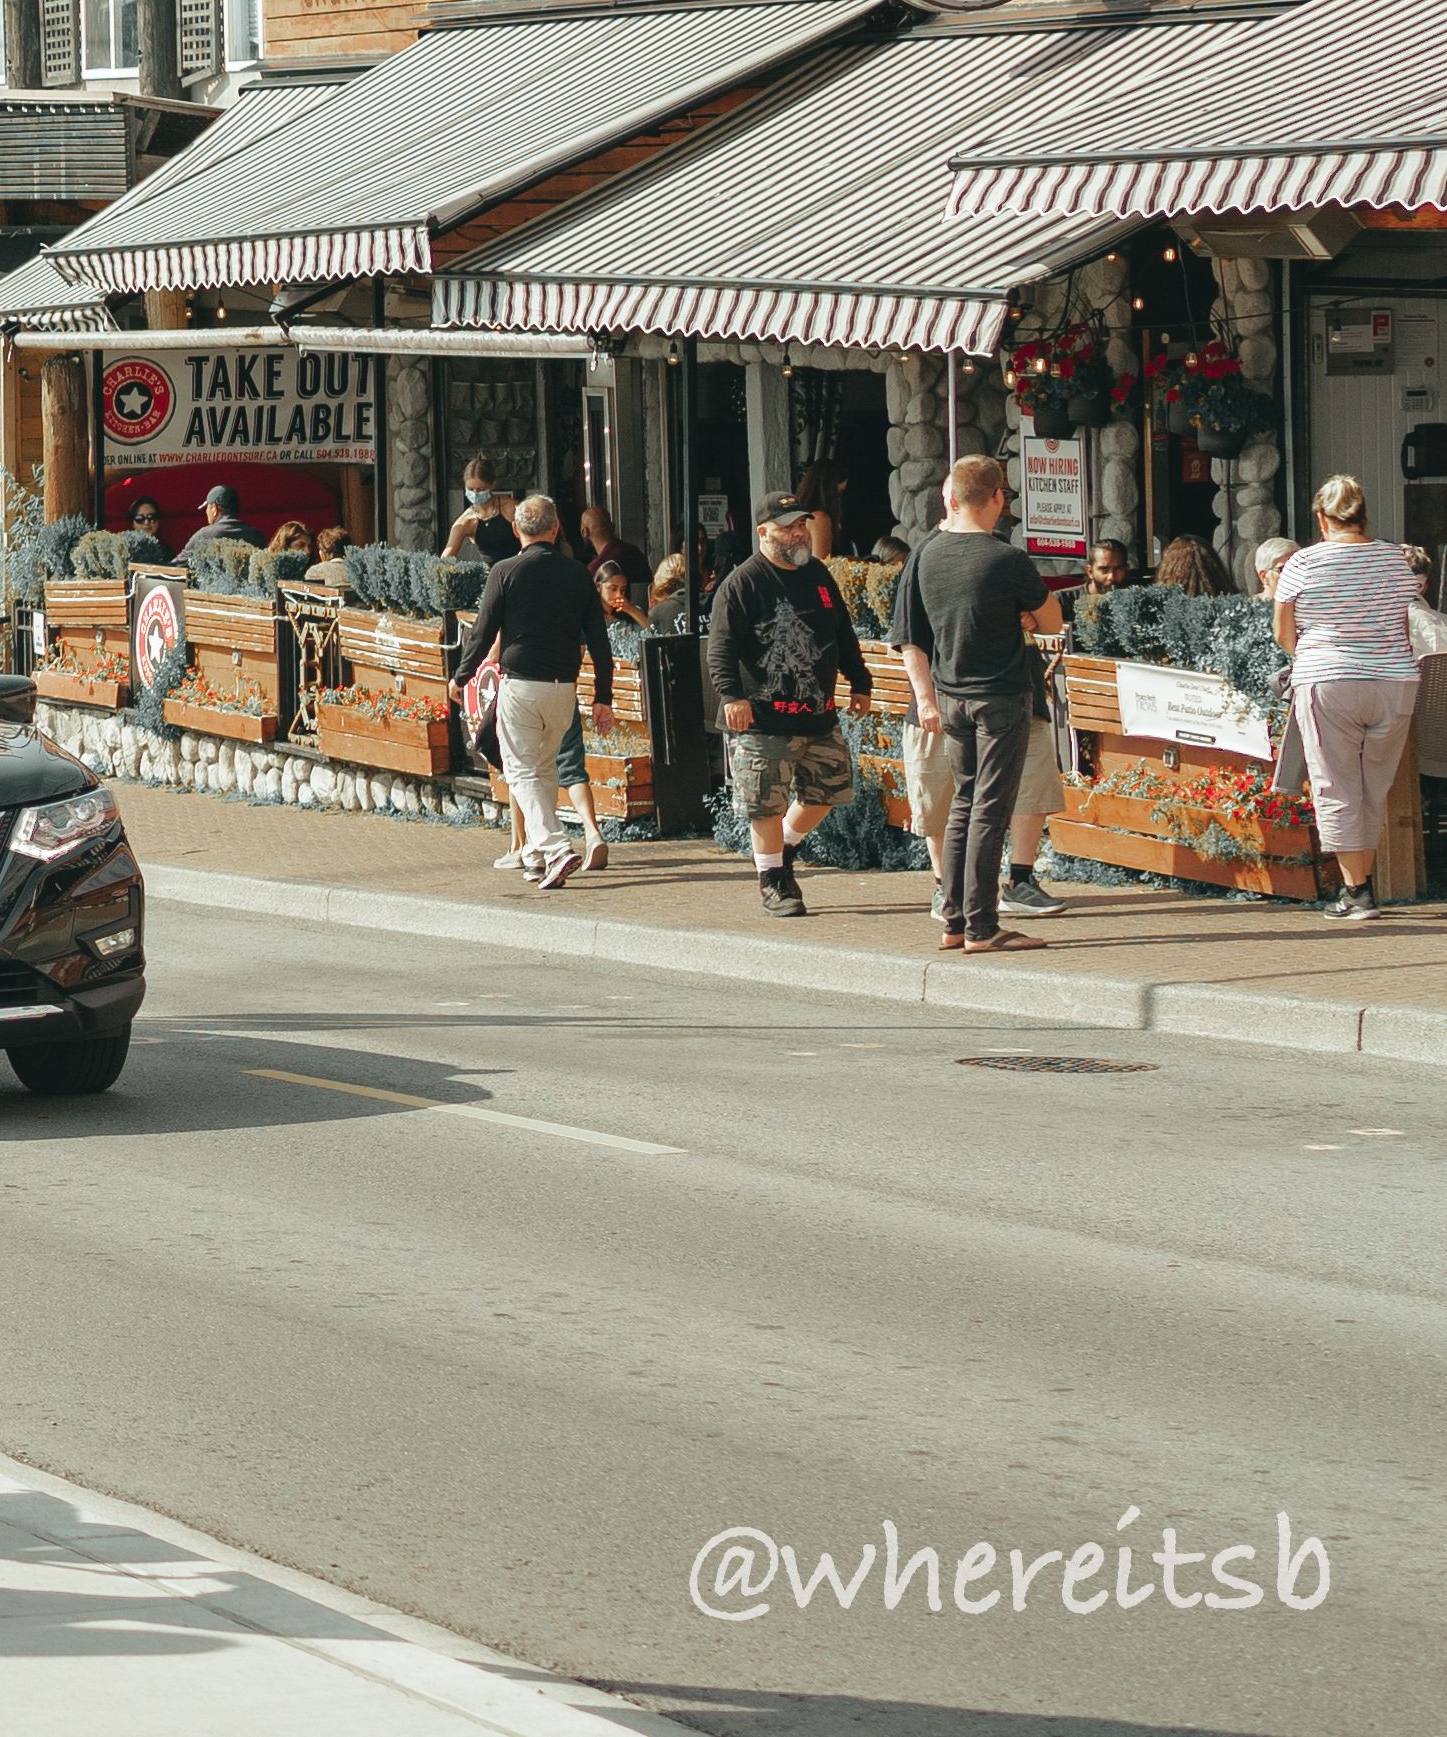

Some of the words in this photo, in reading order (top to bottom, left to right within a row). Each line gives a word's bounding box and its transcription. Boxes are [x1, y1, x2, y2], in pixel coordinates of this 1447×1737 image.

[103, 366, 164, 396] CHARLIE'S
[184, 353, 286, 402] TAKE
[296, 350, 375, 399] OUT
[182, 401, 375, 448] AVAILABLE
[117, 453, 148, 465] ONLINE
[148, 453, 157, 464] AT
[279, 450, 291, 460] OR
[294, 449, 314, 460] CALL
[1027, 456, 1046, 475] NOW
[1049, 457, 1079, 477] HIRING
[1028, 477, 1057, 493] KITCHEN
[1058, 478, 1080, 495] STAFF
